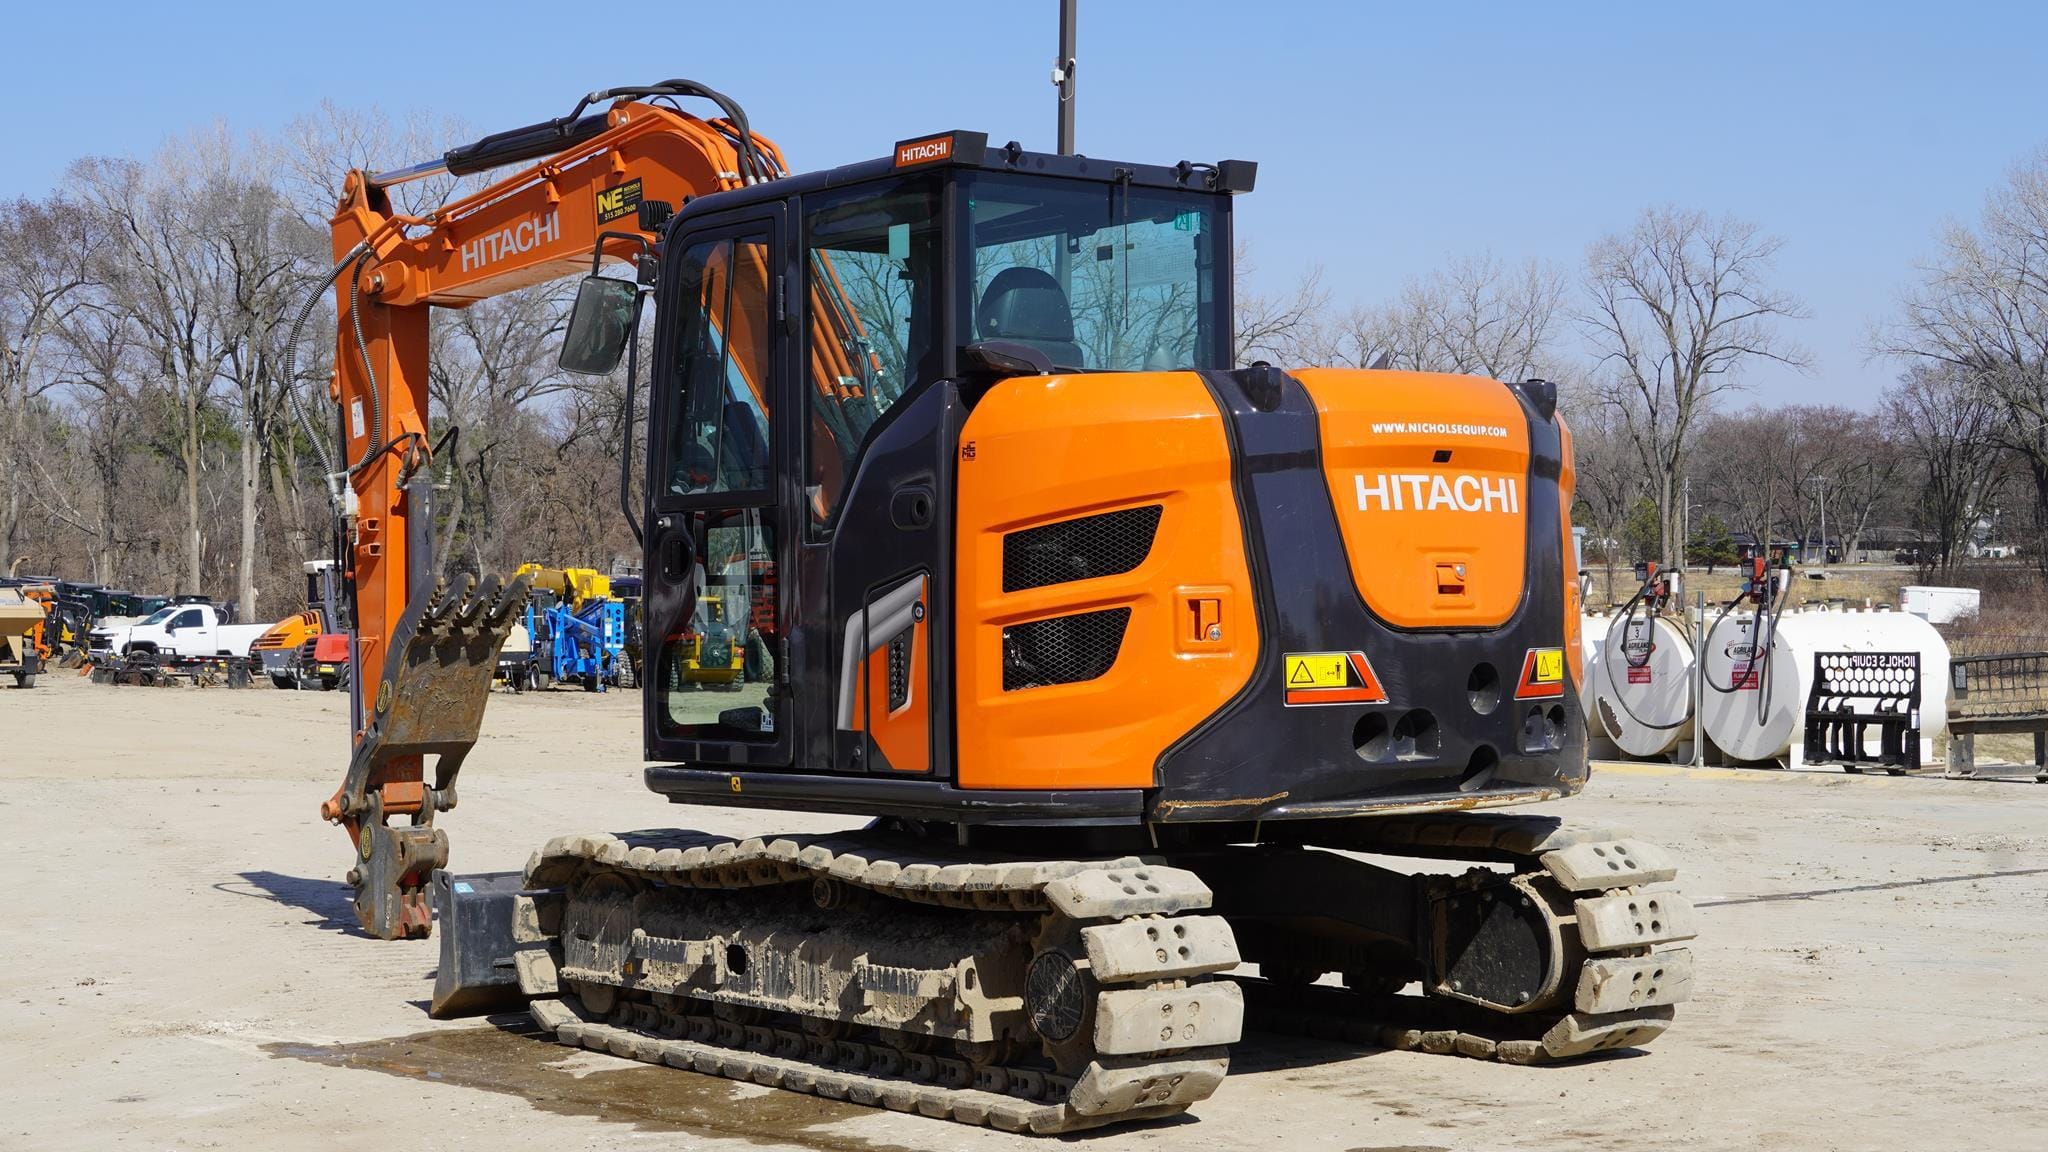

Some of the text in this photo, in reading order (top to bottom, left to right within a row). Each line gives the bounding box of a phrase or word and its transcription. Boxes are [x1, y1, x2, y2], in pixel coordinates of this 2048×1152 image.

[902, 142, 947, 162] HITACHI
[597, 187, 624, 214] NE
[461, 210, 560, 273] HITACHI
[1371, 423, 1508, 437] WWW.NICHOLSEQUIP.COM
[1355, 474, 1519, 513] HITACHI
[1634, 629, 1640, 638] 3
[1741, 624, 1747, 634] 4
